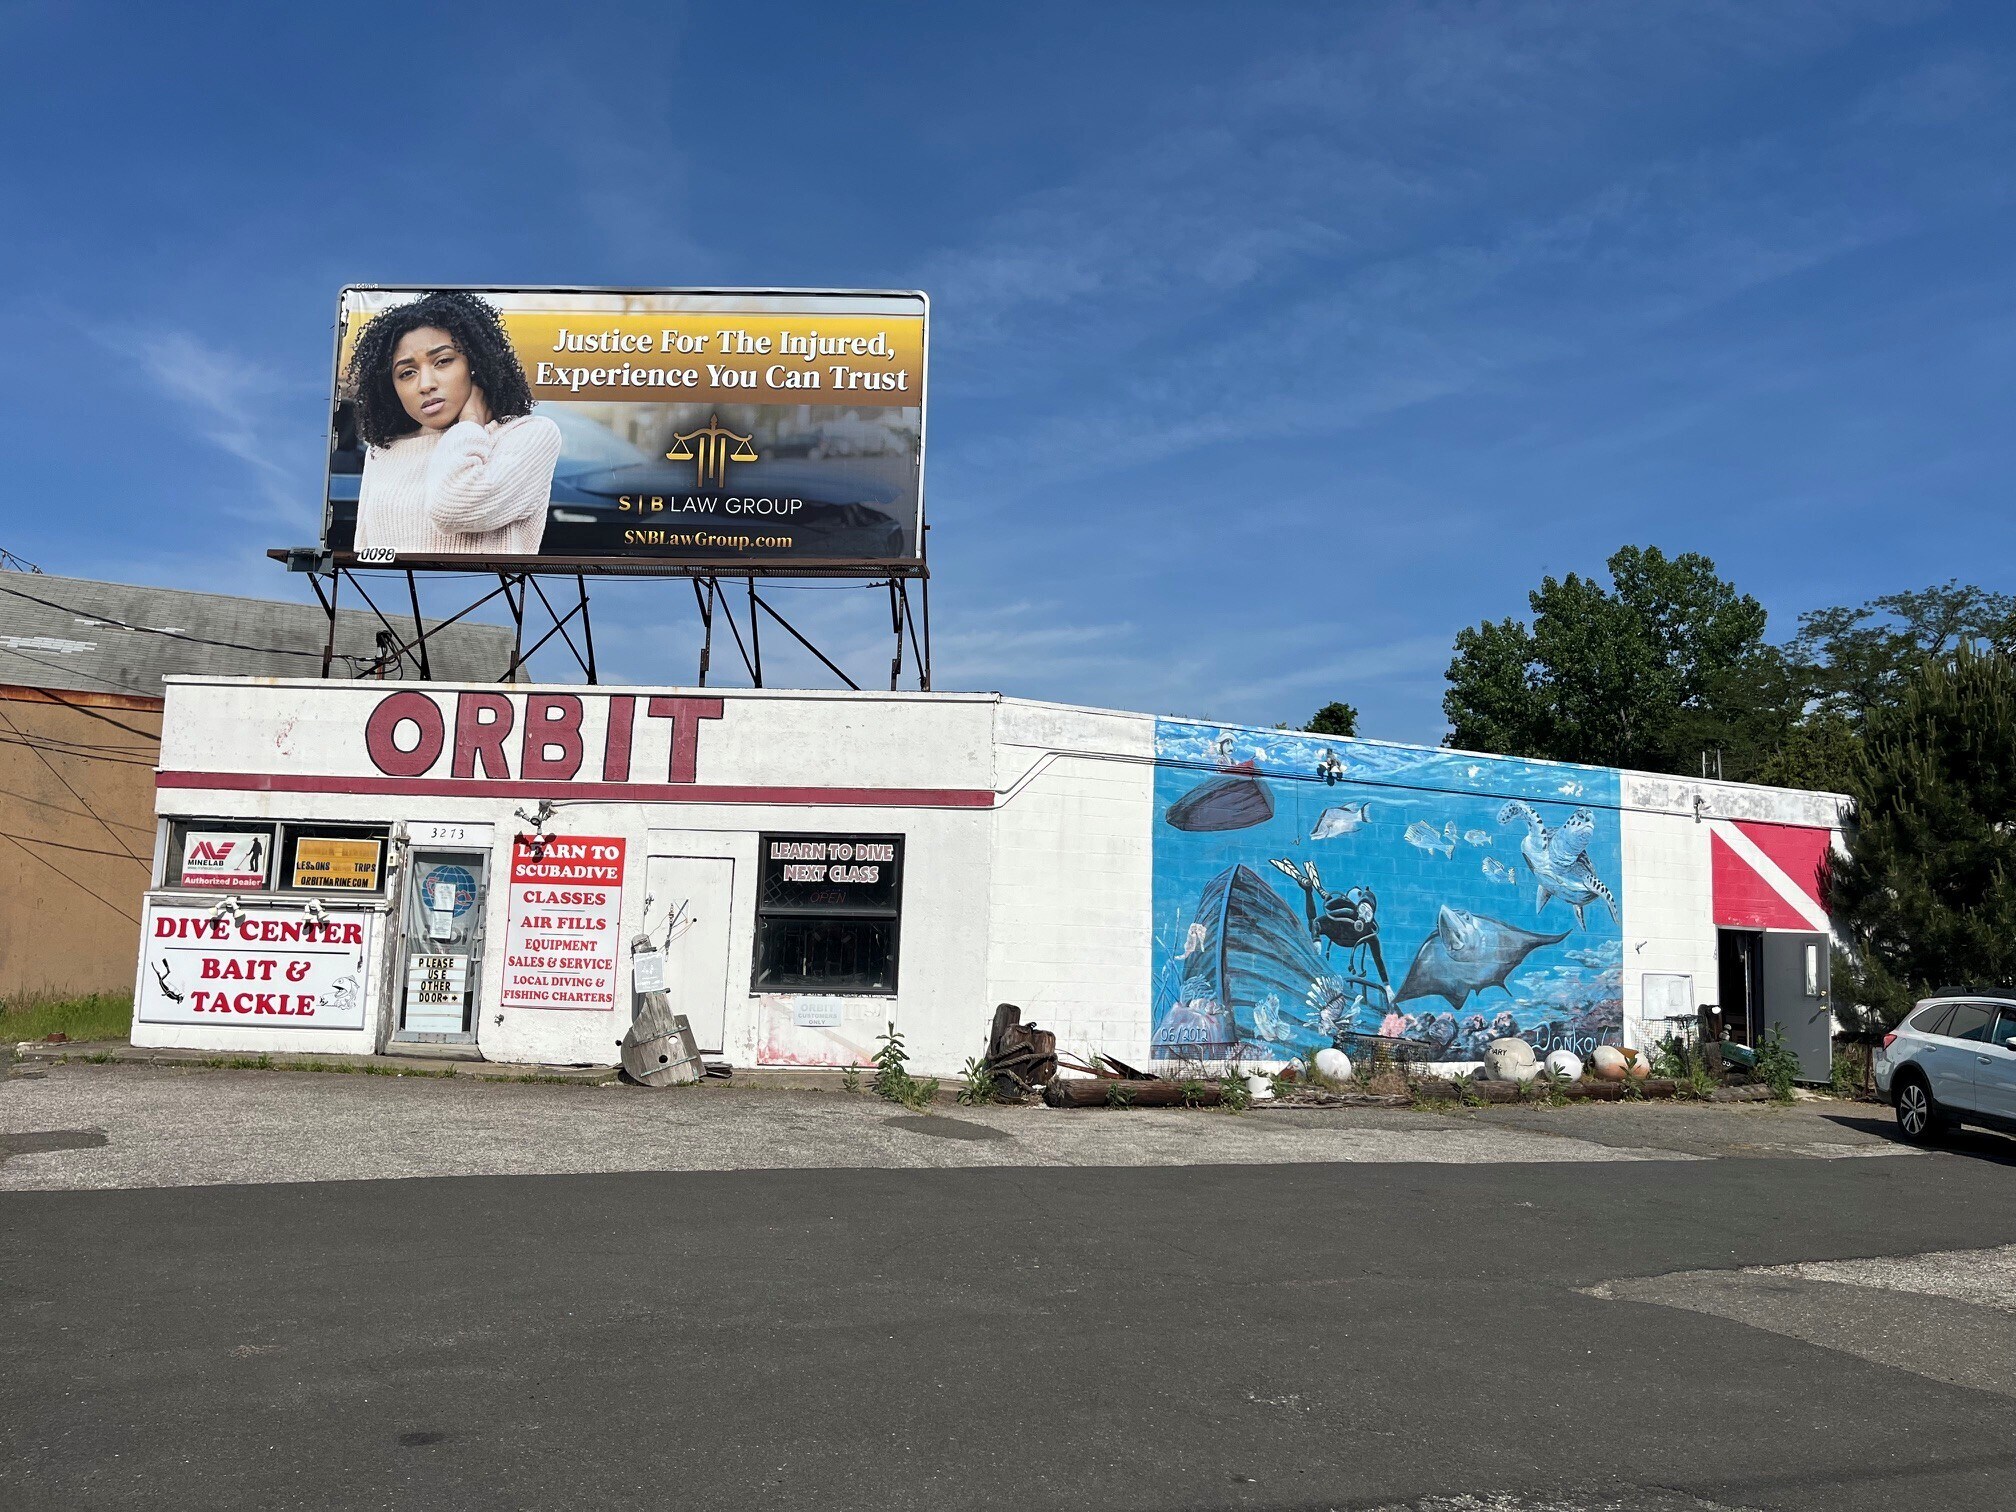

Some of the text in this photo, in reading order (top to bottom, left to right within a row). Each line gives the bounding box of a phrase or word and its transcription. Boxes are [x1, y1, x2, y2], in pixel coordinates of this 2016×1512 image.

[553, 328, 896, 362] Justice For The Injured,
[535, 362, 909, 393] Experience You Can Trust
[618, 495, 631, 512] S
[651, 496, 664, 512] B
[670, 496, 718, 513] LAW
[725, 498, 802, 515] GROUP
[624, 529, 792, 550] SNBLawGroup.com
[361, 547, 395, 561] 0098
[365, 690, 724, 783] ORBIT
[431, 828, 464, 839] 3273
[518, 844, 620, 860] LARN TO
[770, 842, 894, 861] LEARN TO DIVE
[187, 859, 224, 867] MINELAB
[354, 862, 376, 872] TRIPS
[515, 864, 618, 880] SCUBADIVE
[783, 864, 879, 883] NEXT CLASS
[184, 876, 261, 887] Authorized Dealer
[523, 890, 606, 906] CLASSES
[810, 891, 847, 903] OPEN
[520, 915, 607, 930] AIR FILLS
[155, 917, 362, 944] DIVE CENTER
[525, 938, 597, 952] EQUIPMENT
[200, 958, 311, 982] BAIT &
[419, 958, 454, 968] PLEASE
[508, 955, 613, 970] SALES & SERVICE
[428, 970, 447, 979] USE
[513, 975, 605, 988] LOCAL DIVING &
[421, 981, 451, 991] OTHER
[191, 991, 315, 1016] TACKLE
[419, 993, 443, 1002] DOOR
[504, 990, 613, 1003] FISHING CHARTERS
[800, 1003, 835, 1012] ORBIT
[1160, 1025, 1208, 1043] 06/2012
